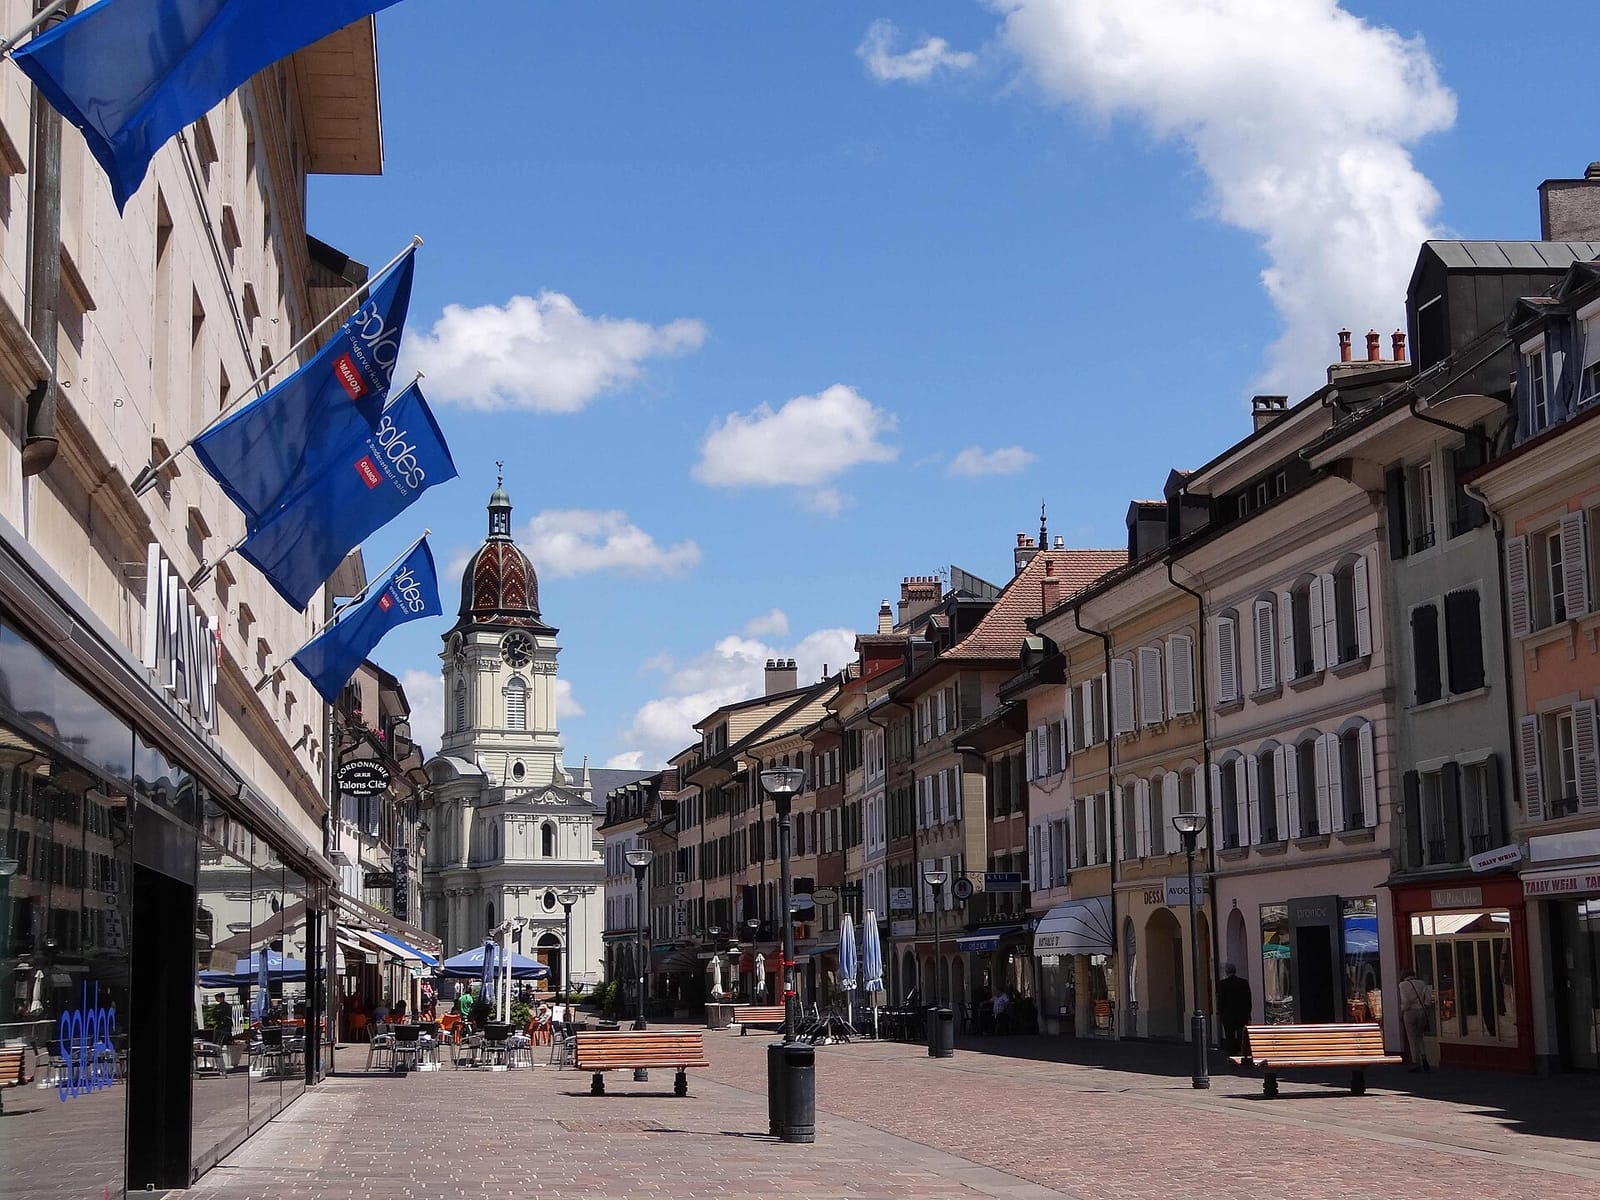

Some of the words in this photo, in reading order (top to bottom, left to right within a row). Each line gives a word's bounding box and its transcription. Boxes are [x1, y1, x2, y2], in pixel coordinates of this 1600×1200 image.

[355, 302, 398, 382] sold
[340, 364, 363, 394] MANOR
[375, 415, 425, 490] soldes
[337, 761, 389, 779] CORDONNERIE
[676, 873, 685, 934] HOTEL
[1168, 886, 1202, 895] AVOCS
[1525, 879, 1550, 894] TALLY
[59, 979, 116, 1103] soldes
